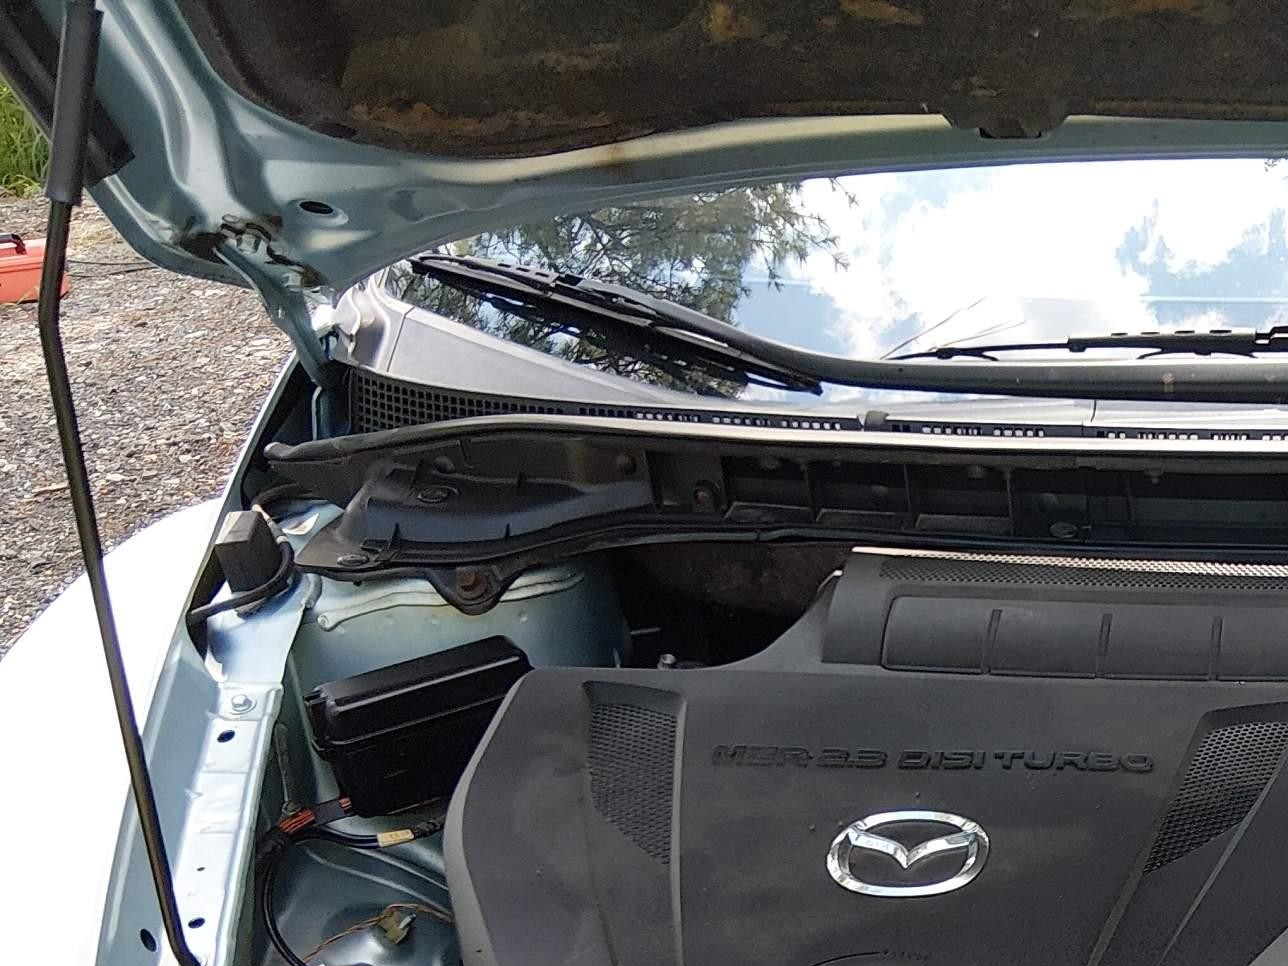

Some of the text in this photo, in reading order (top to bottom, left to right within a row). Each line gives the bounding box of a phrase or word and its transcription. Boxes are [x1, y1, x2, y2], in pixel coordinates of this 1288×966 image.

[712, 745, 1155, 773] MZR 2.3 DISI TURBO
